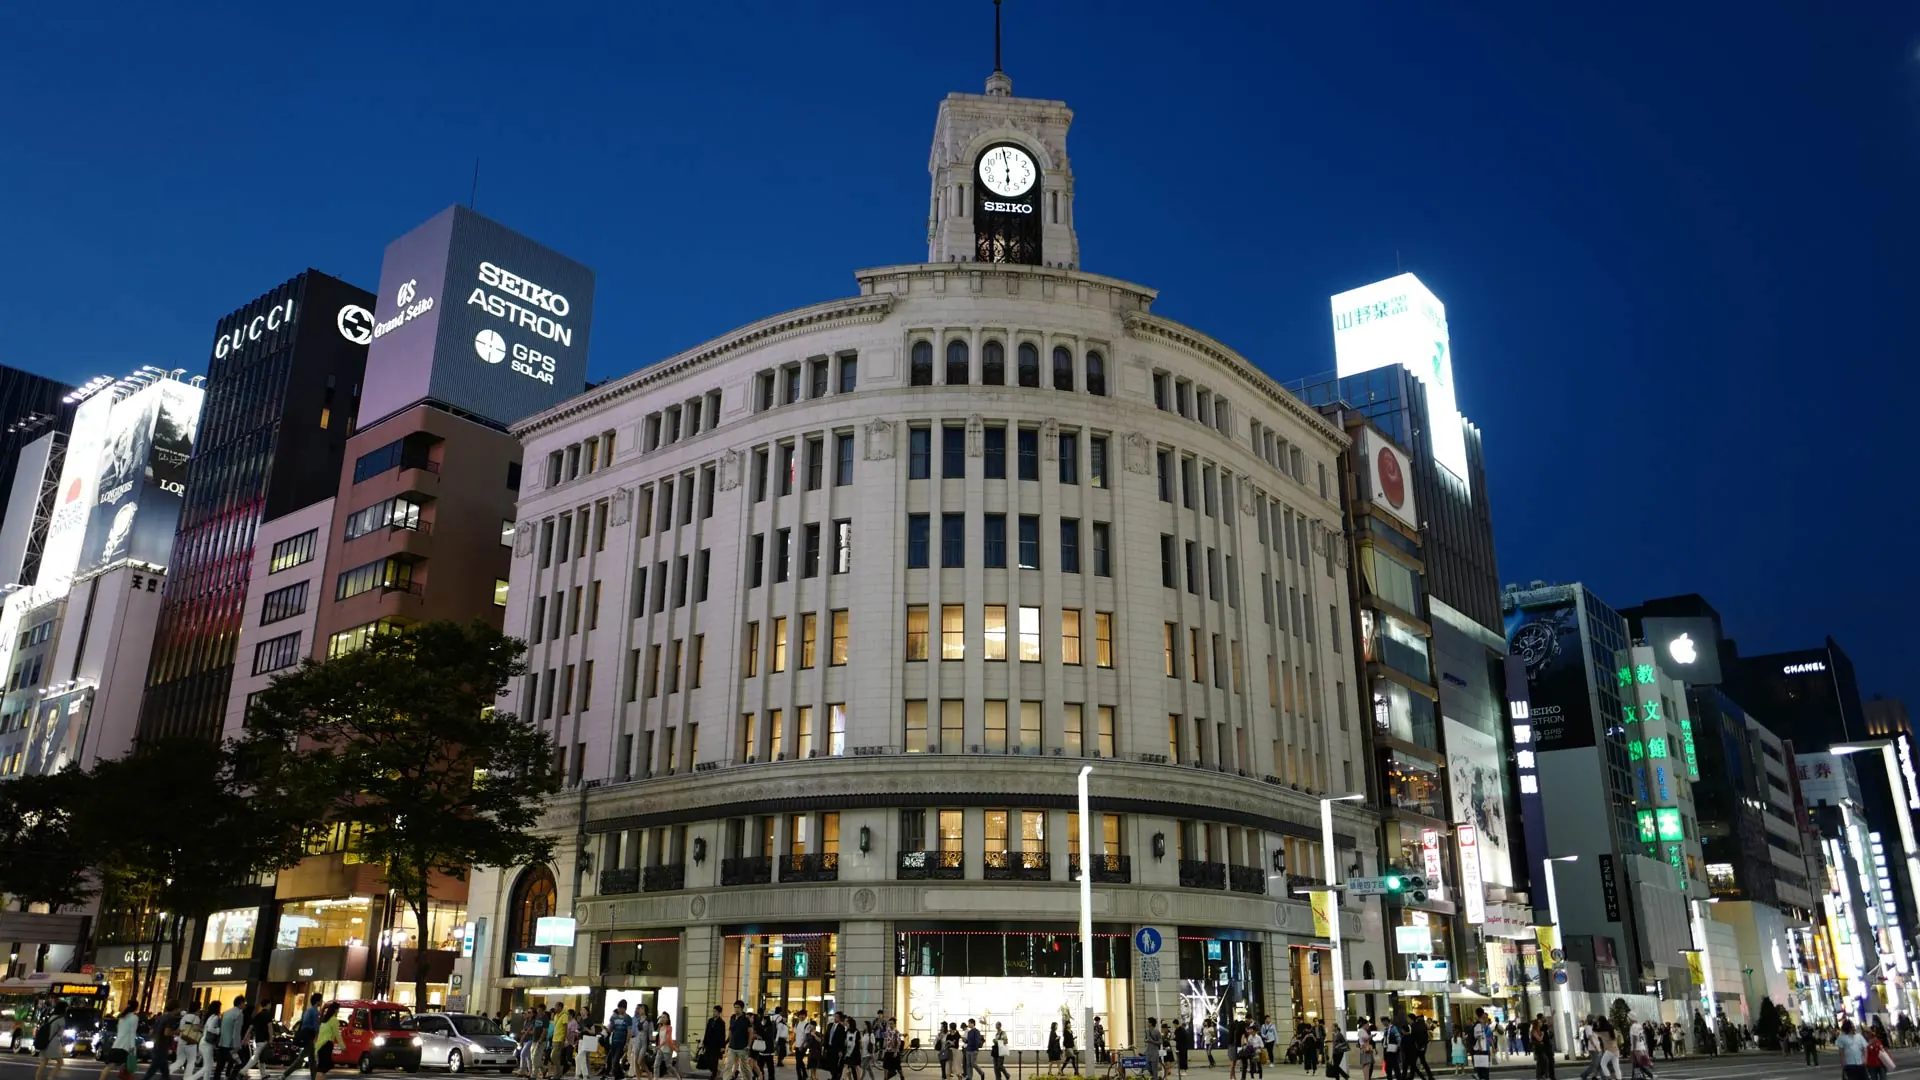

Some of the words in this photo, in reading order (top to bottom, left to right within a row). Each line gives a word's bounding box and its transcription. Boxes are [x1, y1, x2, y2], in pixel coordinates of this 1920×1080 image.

[984, 201, 1033, 214] SEIKO
[478, 260, 570, 318] SEIKO
[215, 299, 293, 360] GUCCI
[373, 309, 405, 339] Grand
[405, 296, 434, 322] Seiko
[467, 286, 573, 348] ASTRON
[510, 359, 555, 385] SOLAR
[511, 342, 556, 373] GPS
[100, 480, 134, 504] LONGINES
[1783, 661, 1826, 674] CHANEL
[1635, 663, 1667, 759] 教文館
[1603, 866, 1616, 909] ZENITH
